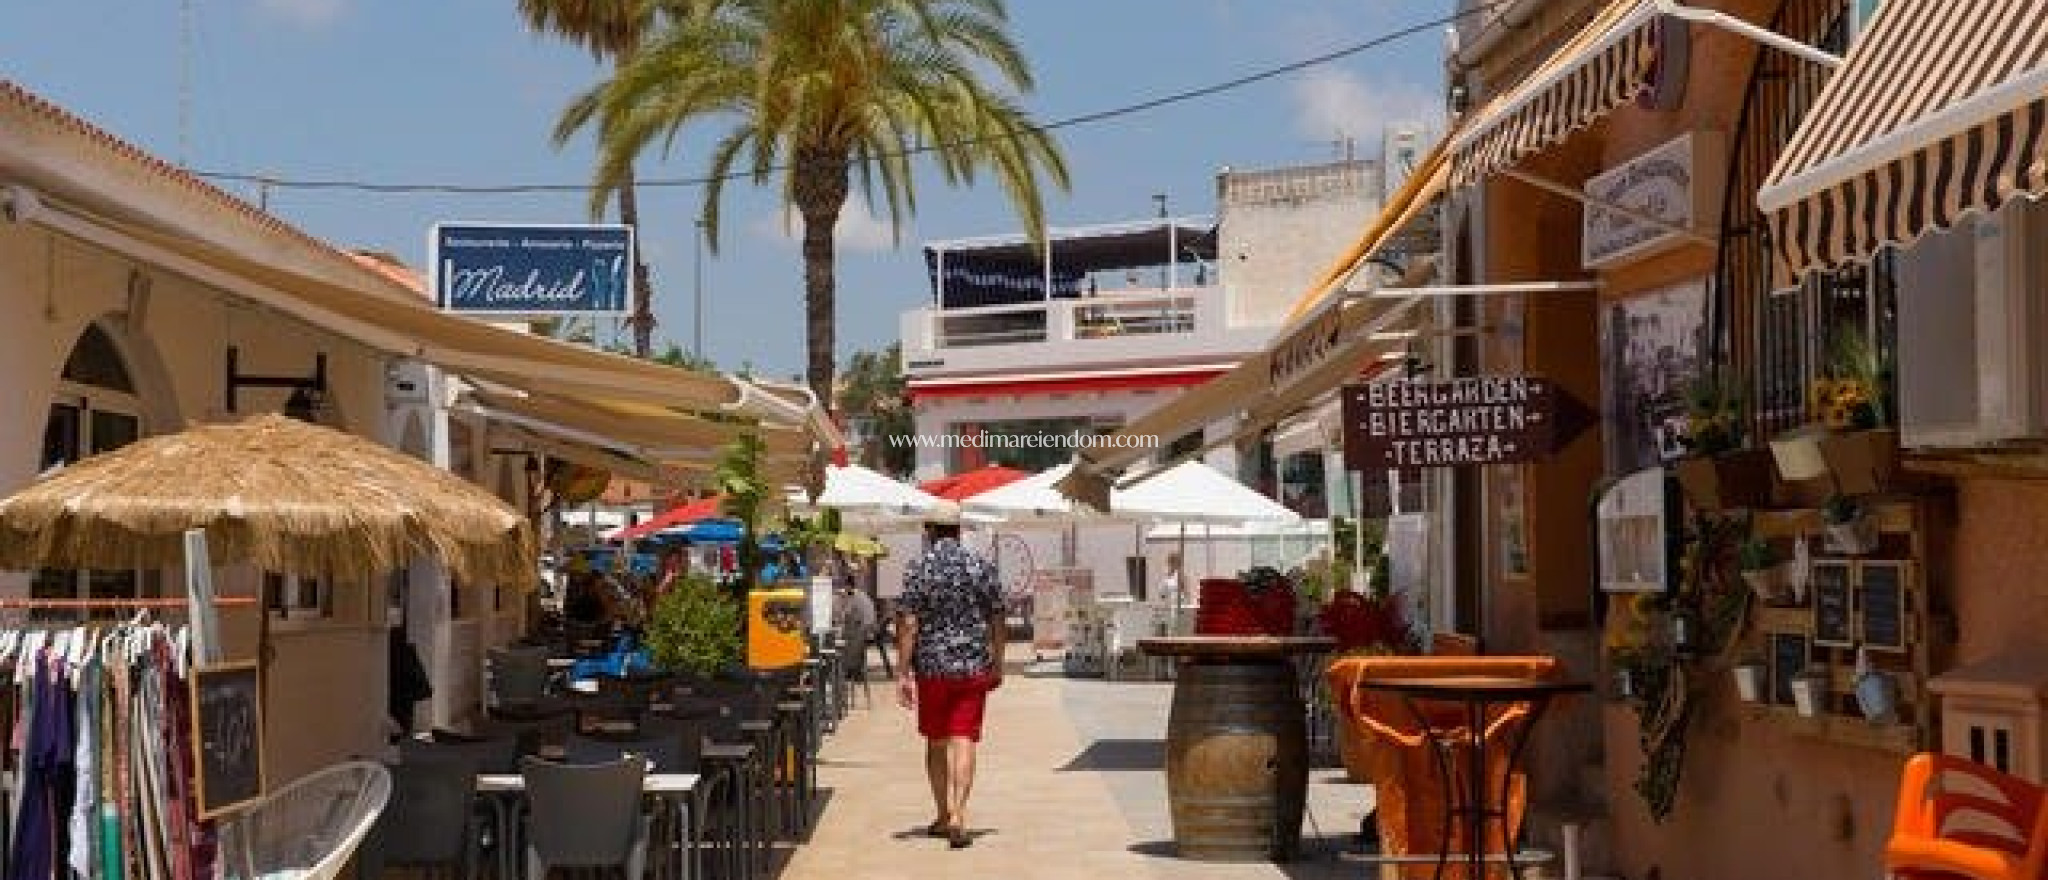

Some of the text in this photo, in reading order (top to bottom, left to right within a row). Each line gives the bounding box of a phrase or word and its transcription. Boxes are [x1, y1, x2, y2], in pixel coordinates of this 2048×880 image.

[453, 264, 586, 302] Madrid
[1369, 405, 1524, 436] BIERGARTEN
[1392, 435, 1502, 465] TERRAZA
